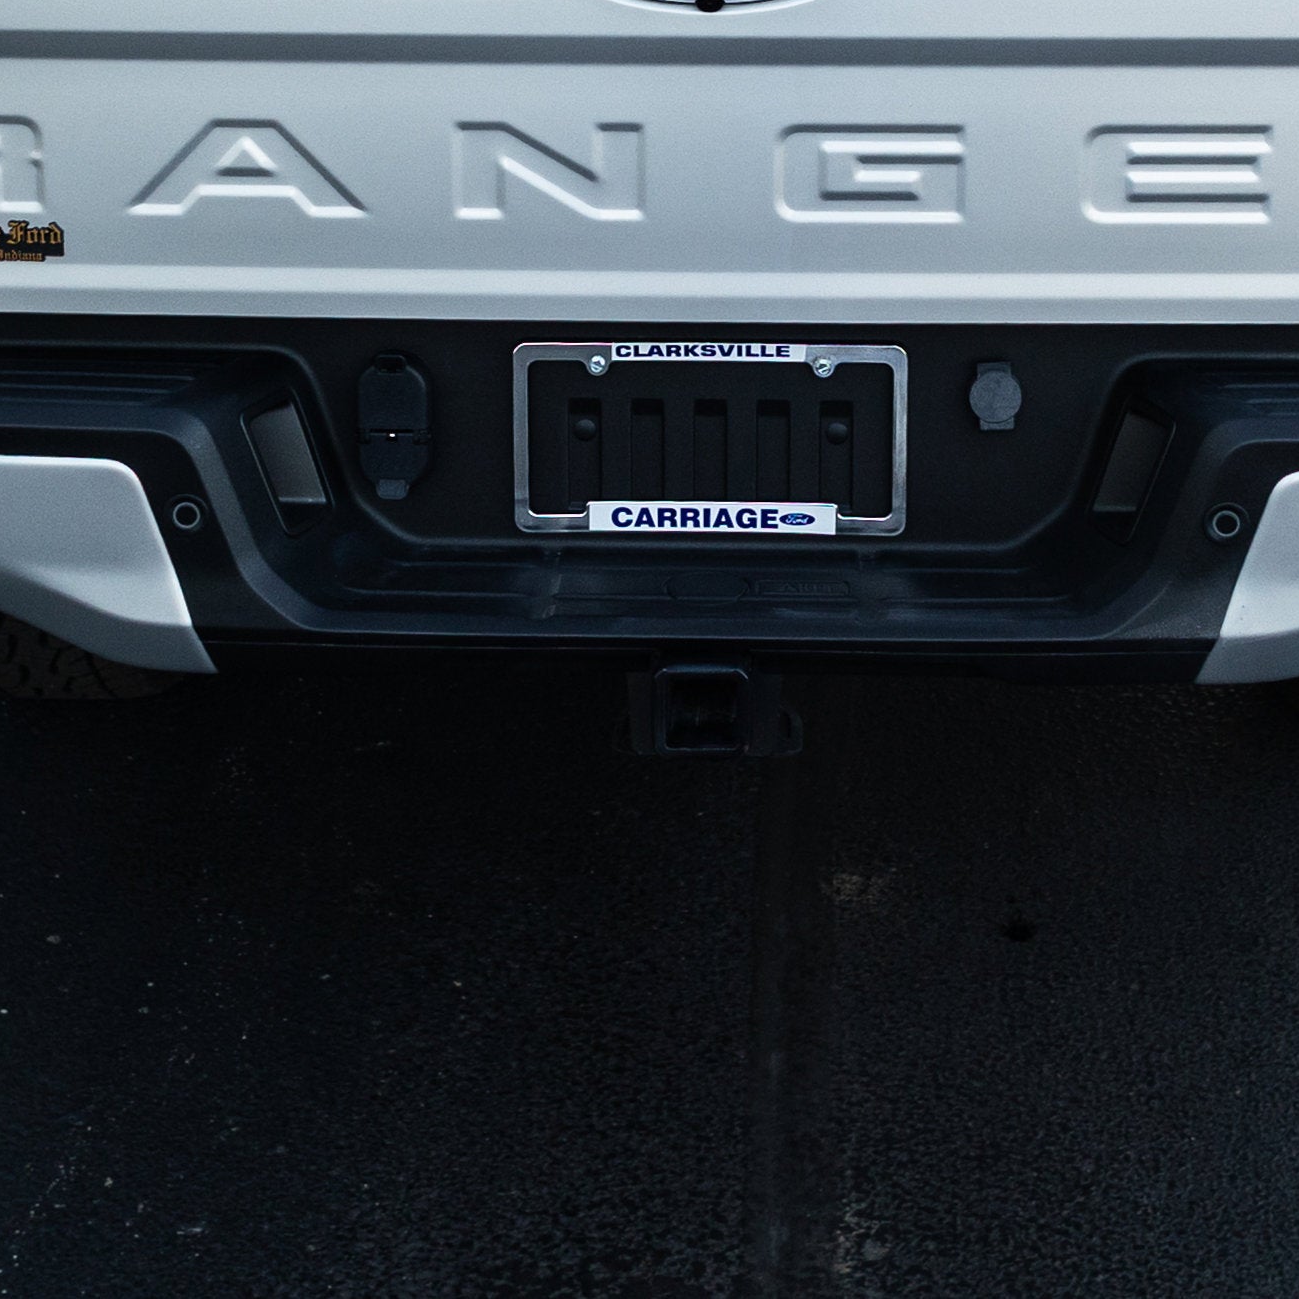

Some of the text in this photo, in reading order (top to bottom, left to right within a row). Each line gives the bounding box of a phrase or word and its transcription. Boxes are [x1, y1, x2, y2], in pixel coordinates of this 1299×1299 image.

[7, 220, 63, 246] Ford
[615, 344, 791, 358] CLARKSVILLE
[611, 507, 779, 529] CARRIAGE
